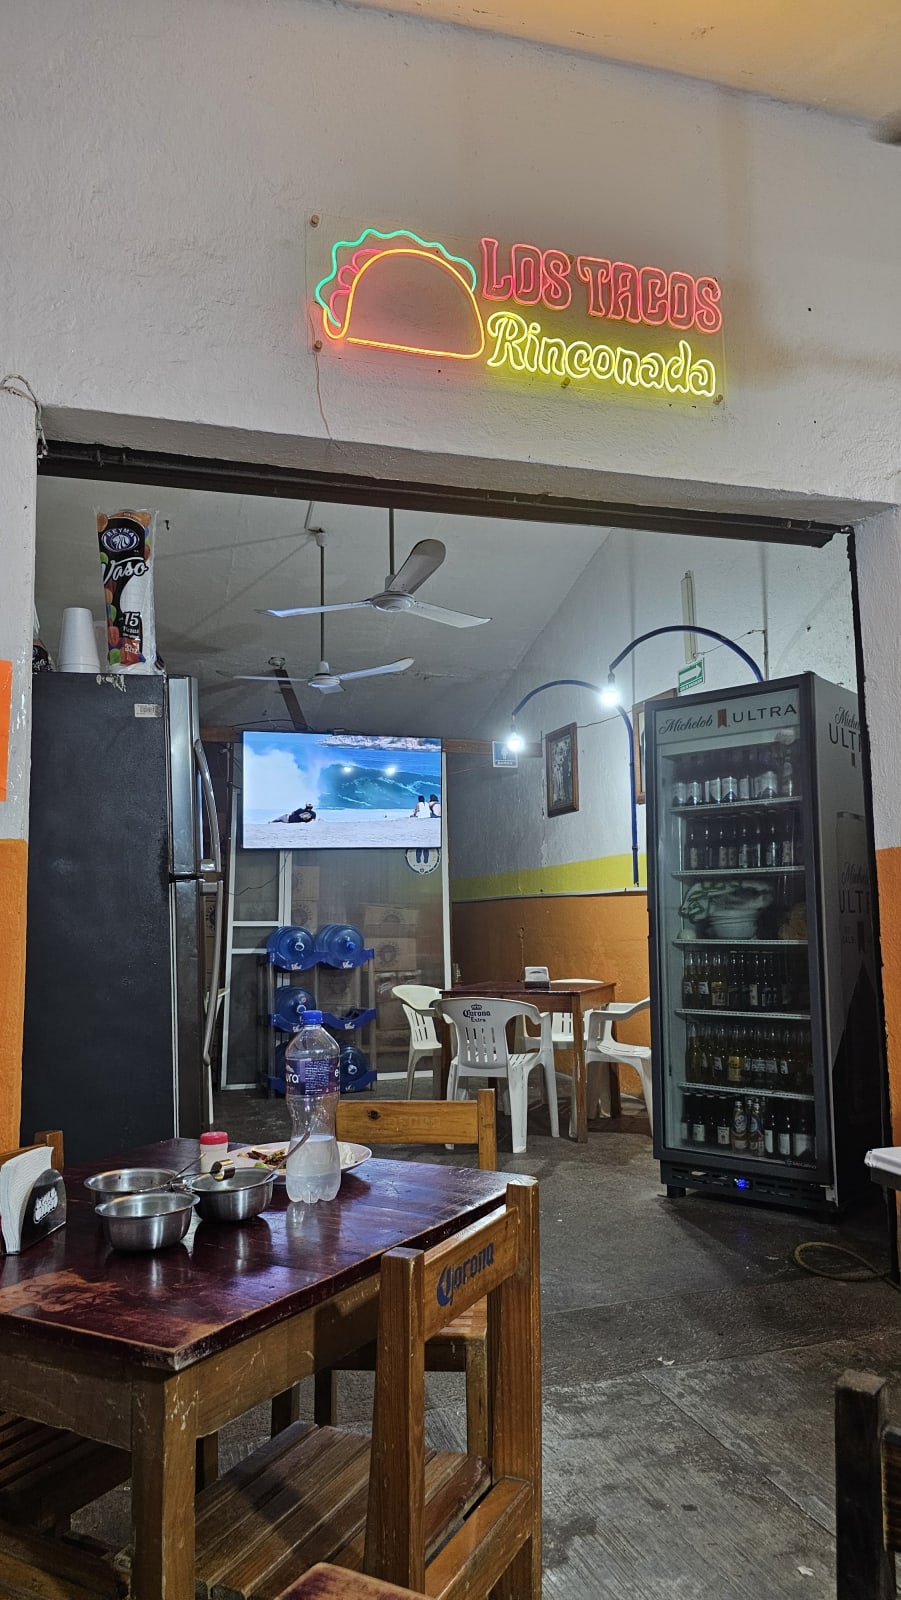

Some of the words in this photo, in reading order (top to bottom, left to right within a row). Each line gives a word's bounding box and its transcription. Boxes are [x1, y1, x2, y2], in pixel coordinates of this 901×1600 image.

[480, 237, 572, 312] LOS
[577, 255, 722, 334] TACOS
[487, 310, 717, 398] Rinconada
[106, 528, 135, 537] REYMA
[101, 557, 149, 584] Vaso
[124, 612, 140, 627] 15
[659, 714, 713, 735] Michelob
[733, 703, 797, 723] ULTRA
[829, 722, 862, 753] ULT
[462, 1009, 490, 1018] Corona
[436, 1242, 495, 1306] Corona
